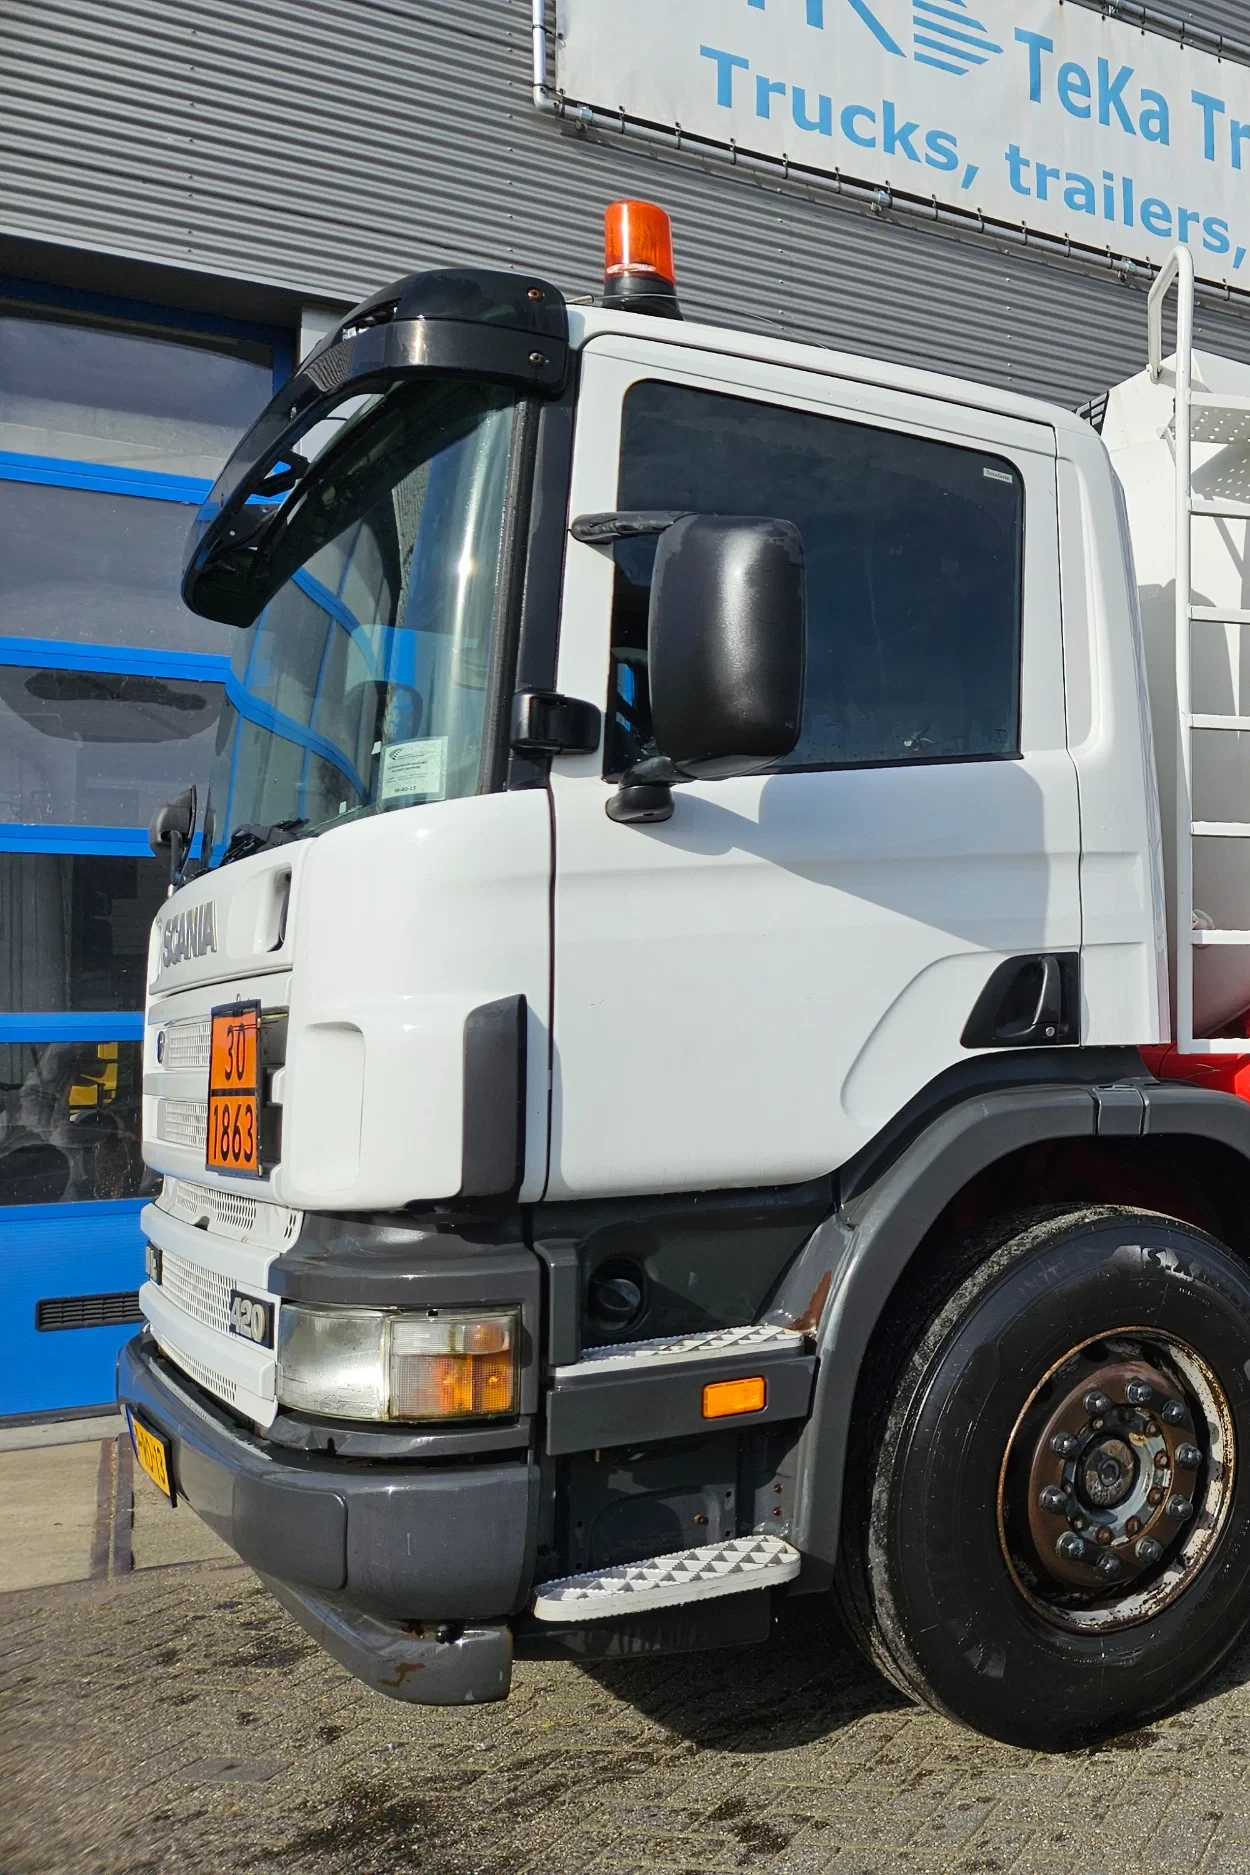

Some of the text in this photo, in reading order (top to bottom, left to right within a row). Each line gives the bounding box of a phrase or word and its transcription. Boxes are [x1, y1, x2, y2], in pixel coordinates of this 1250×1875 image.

[1015, 28, 1170, 146] TeKa
[700, 45, 979, 190] Trucks,
[1004, 144, 1247, 269] trailers,
[163, 901, 217, 967] SCANIA
[225, 1022, 246, 1081] 30
[213, 1104, 254, 1163] 1863
[230, 1297, 266, 1343] 420
